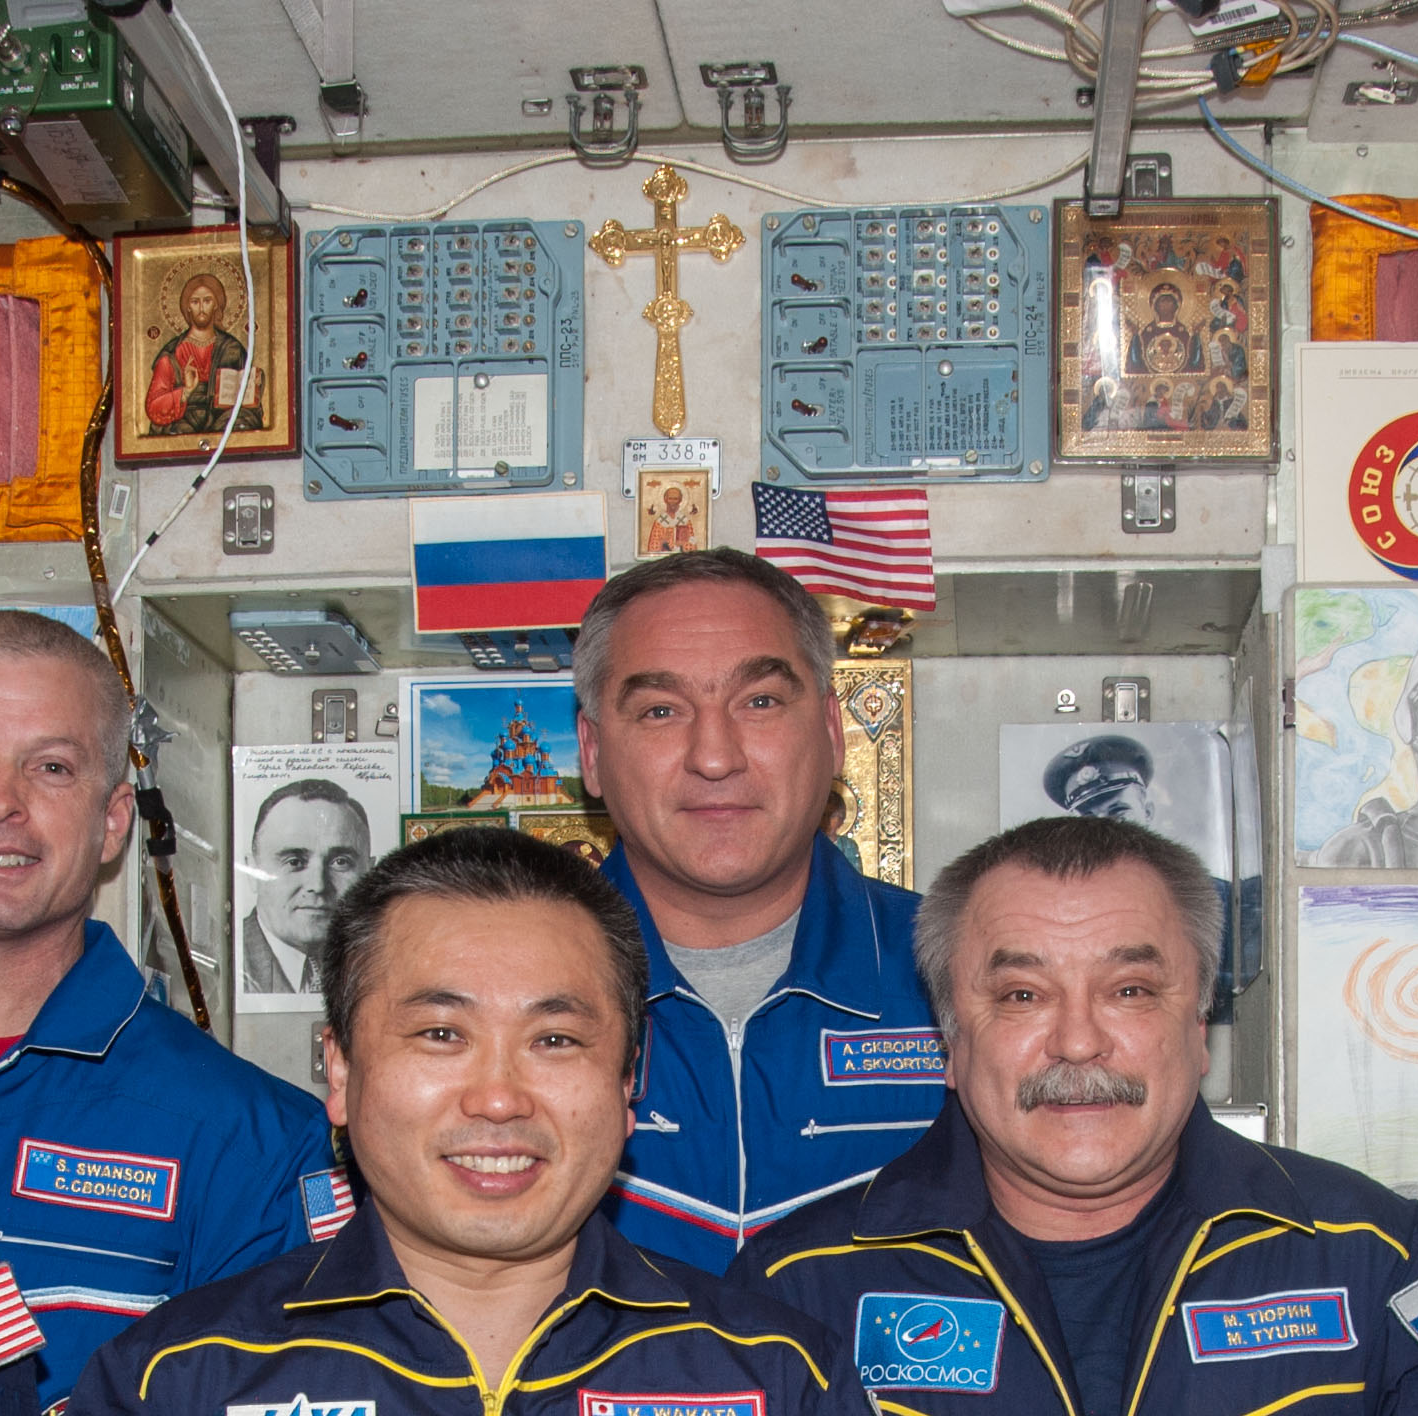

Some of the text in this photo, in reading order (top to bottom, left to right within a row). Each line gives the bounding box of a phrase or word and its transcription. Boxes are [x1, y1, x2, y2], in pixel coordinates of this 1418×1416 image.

[1025, 304, 1037, 355] ППС-24
[560, 318, 572, 368] ППС-23
[659, 444, 694, 460] 338
[1360, 445, 1397, 549] СОЮЗ
[57, 1158, 157, 1186] S. SWANSON
[1223, 1304, 1312, 1328] М. ТЮРИН
[1227, 1322, 1318, 1346] M. TYURIN
[861, 1364, 988, 1386] РОСКОСМОС
